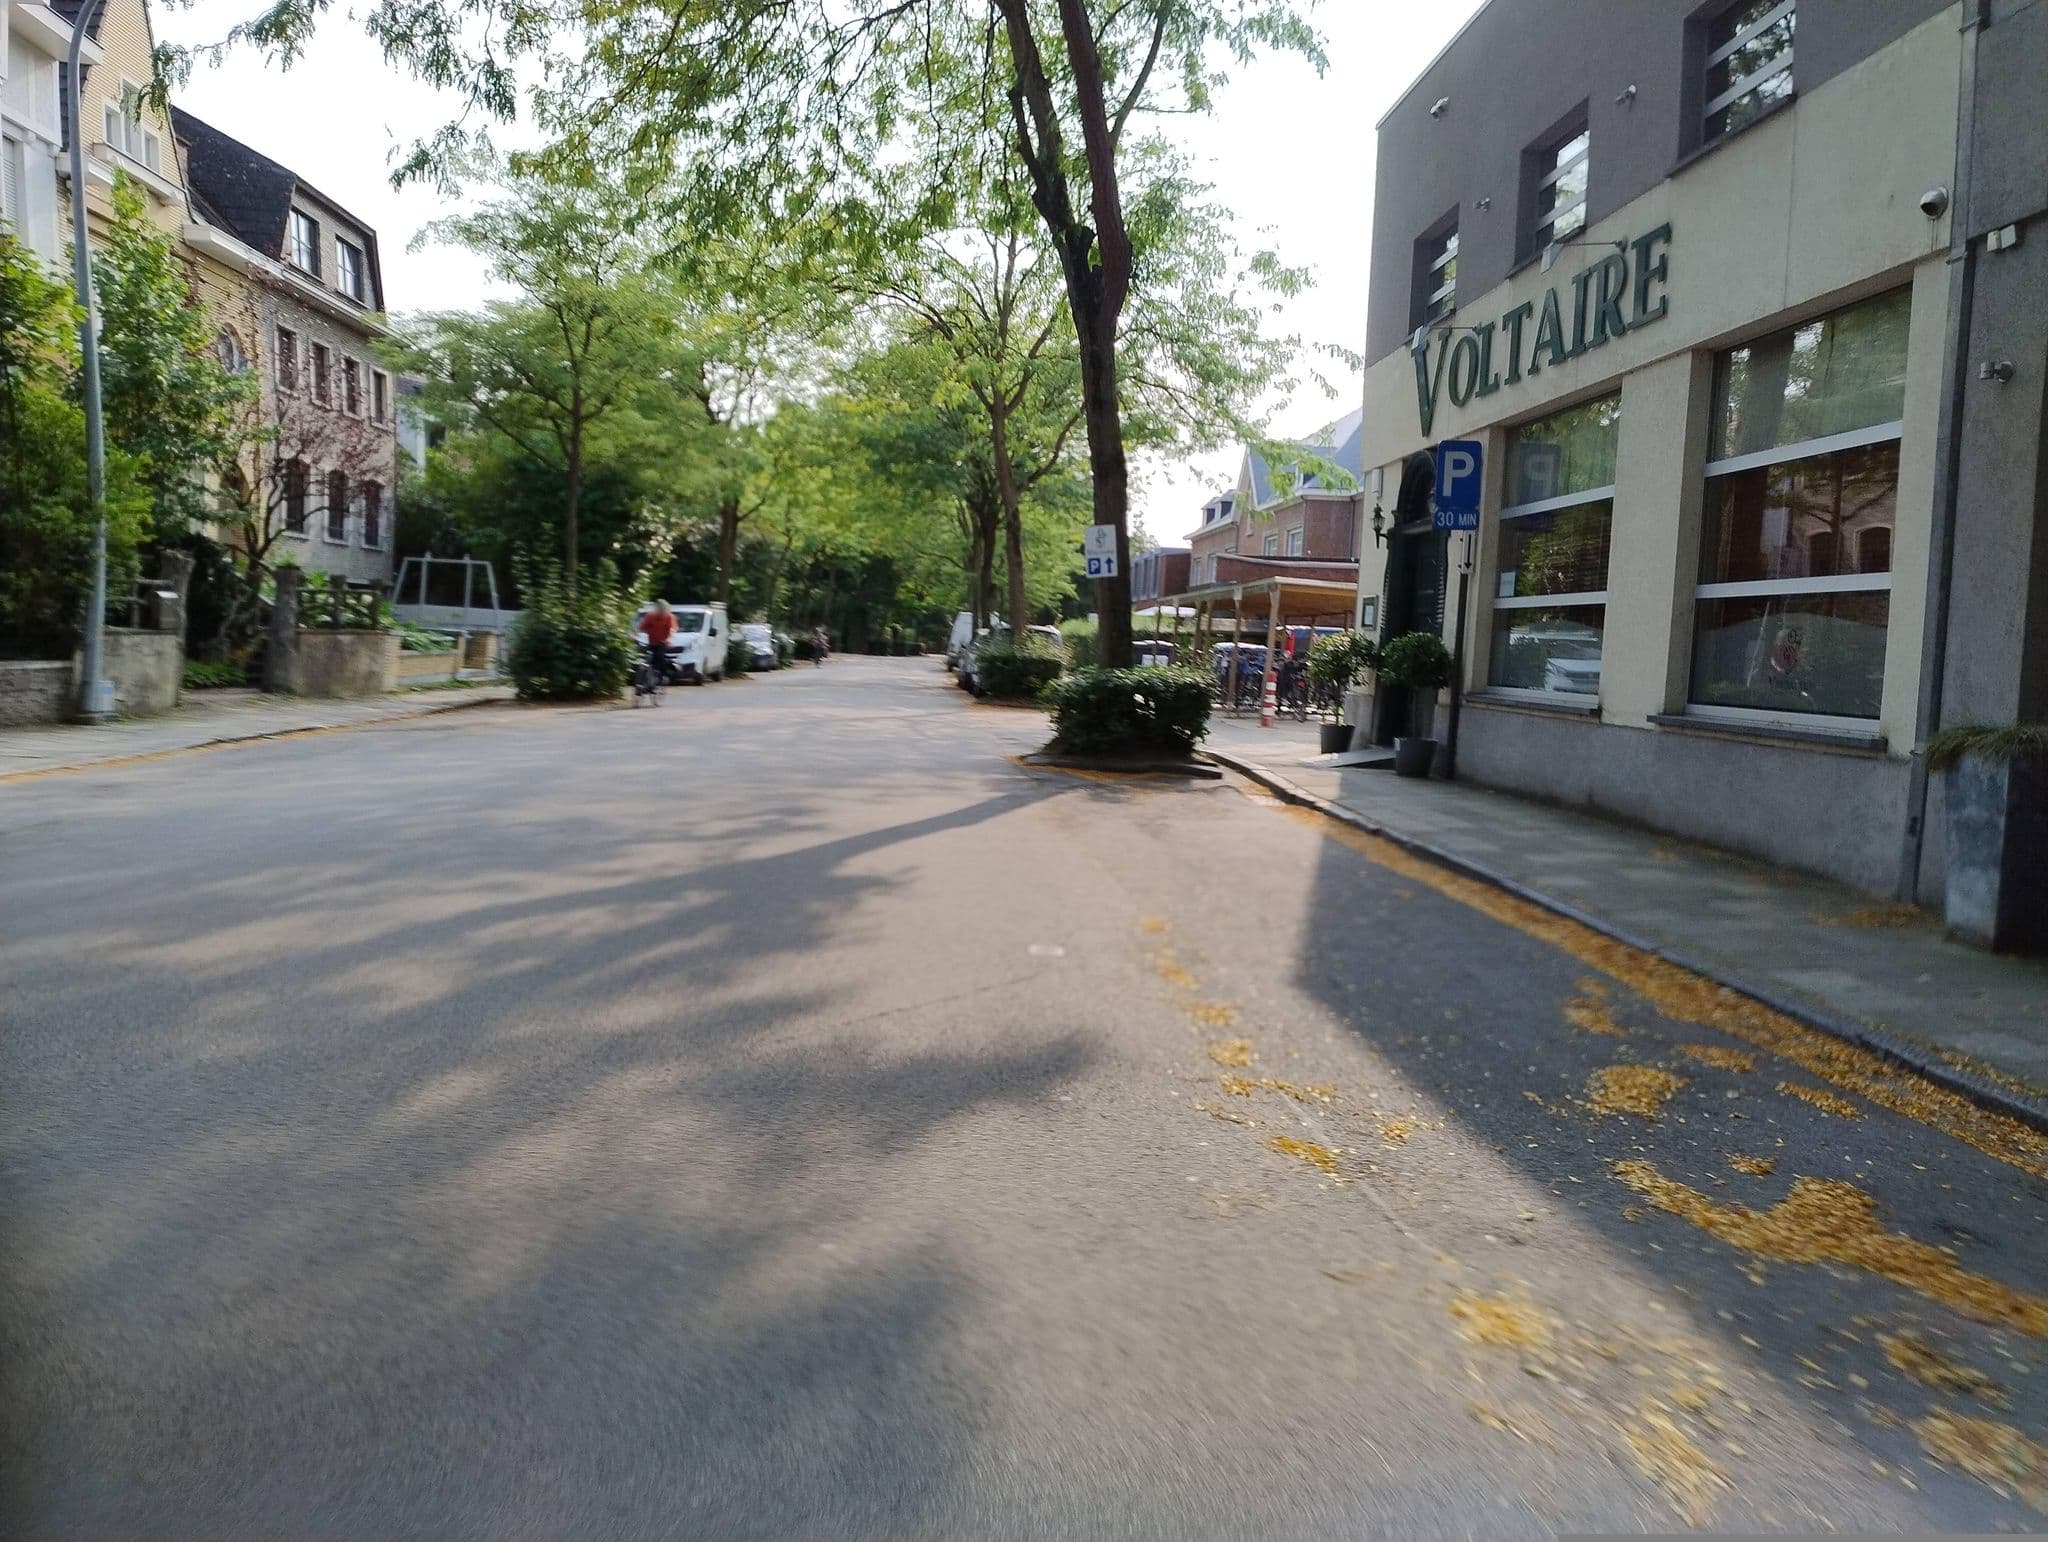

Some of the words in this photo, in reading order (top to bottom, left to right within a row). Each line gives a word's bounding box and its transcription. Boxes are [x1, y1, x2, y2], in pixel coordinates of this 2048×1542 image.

[1411, 222, 1672, 437] VOLTAIRE
[1442, 450, 1475, 497] P
[1437, 511, 1454, 527] 30
[1458, 512, 1477, 526] MIN
[1090, 560, 1099, 573] P
